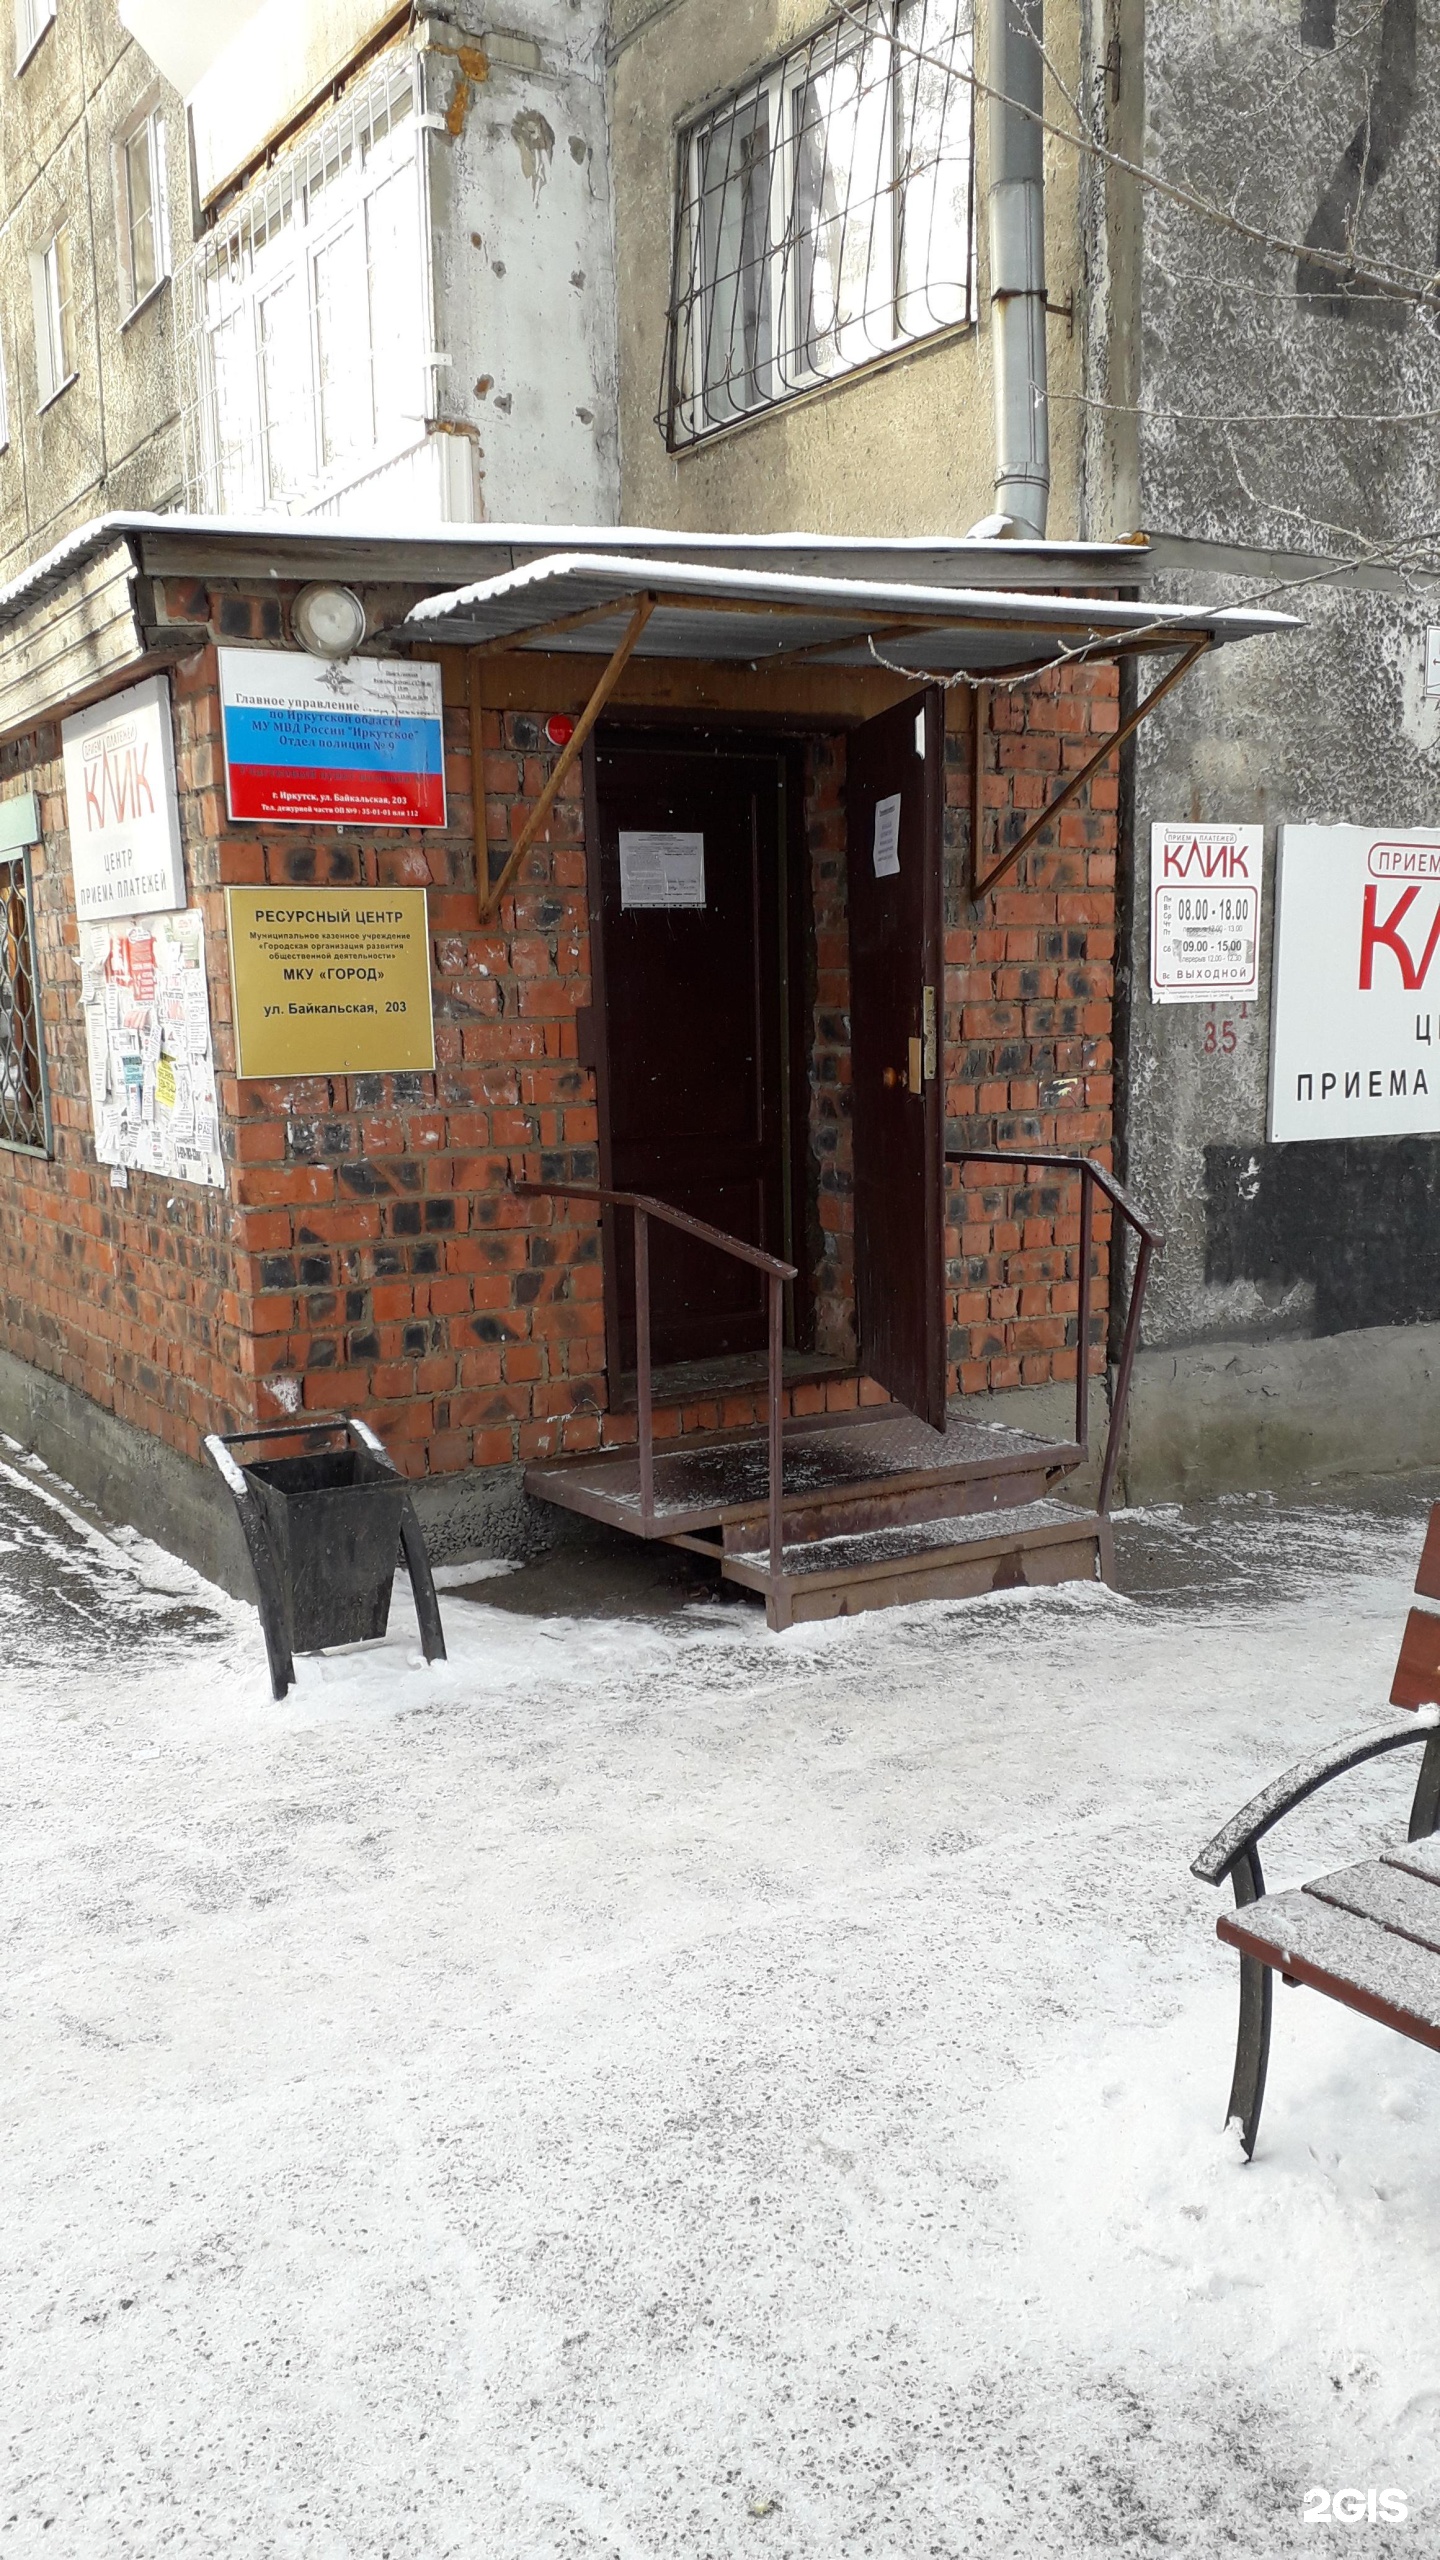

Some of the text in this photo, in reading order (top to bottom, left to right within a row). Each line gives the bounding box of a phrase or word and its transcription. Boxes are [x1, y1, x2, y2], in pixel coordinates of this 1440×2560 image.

[236, 693, 285, 706] Главное
[288, 698, 360, 710] управление
[270, 711, 284, 719] по
[287, 709, 352, 724] Иркутской
[354, 714, 401, 726] области
[252, 720, 418, 740] МУ МВД России "Иркутское"
[280, 735, 394, 750] Отдел полиции № 9
[84, 739, 155, 832] КЛИК
[280, 790, 319, 802] Иркутск,
[320, 794, 332, 802] ул.
[334, 793, 390, 804] Байкальская,
[392, 796, 407, 804] 203
[1199, 834, 1234, 842] ПЛАТЕЖЕЙ
[104, 848, 132, 875] ЦЕНТР
[1164, 836, 1249, 878] КЛИК
[80, 868, 167, 906] ПРИЕМА ПЛАТЕЖЕЙ
[256, 908, 403, 925] РЕСУРСНЫЙ ЦЕНТР
[1178, 899, 1208, 920] 08.00
[1219, 899, 1248, 920] 18.00
[250, 932, 320, 940] Муниципальное
[259, 942, 309, 950] «Городская
[1183, 940, 1208, 952] 09.00
[1218, 940, 1242, 951] 15.00
[284, 968, 384, 981] МКУ «ГОРОД»
[1177, 967, 1246, 980] ВЫХОДНОЙ
[264, 1001, 407, 1017] ул. Байкальская, 203
[1204, 1020, 1237, 1054] 35
[1416, 1014, 1440, 1046] Ц
[1297, 1069, 1428, 1101] ПРИЕМА
